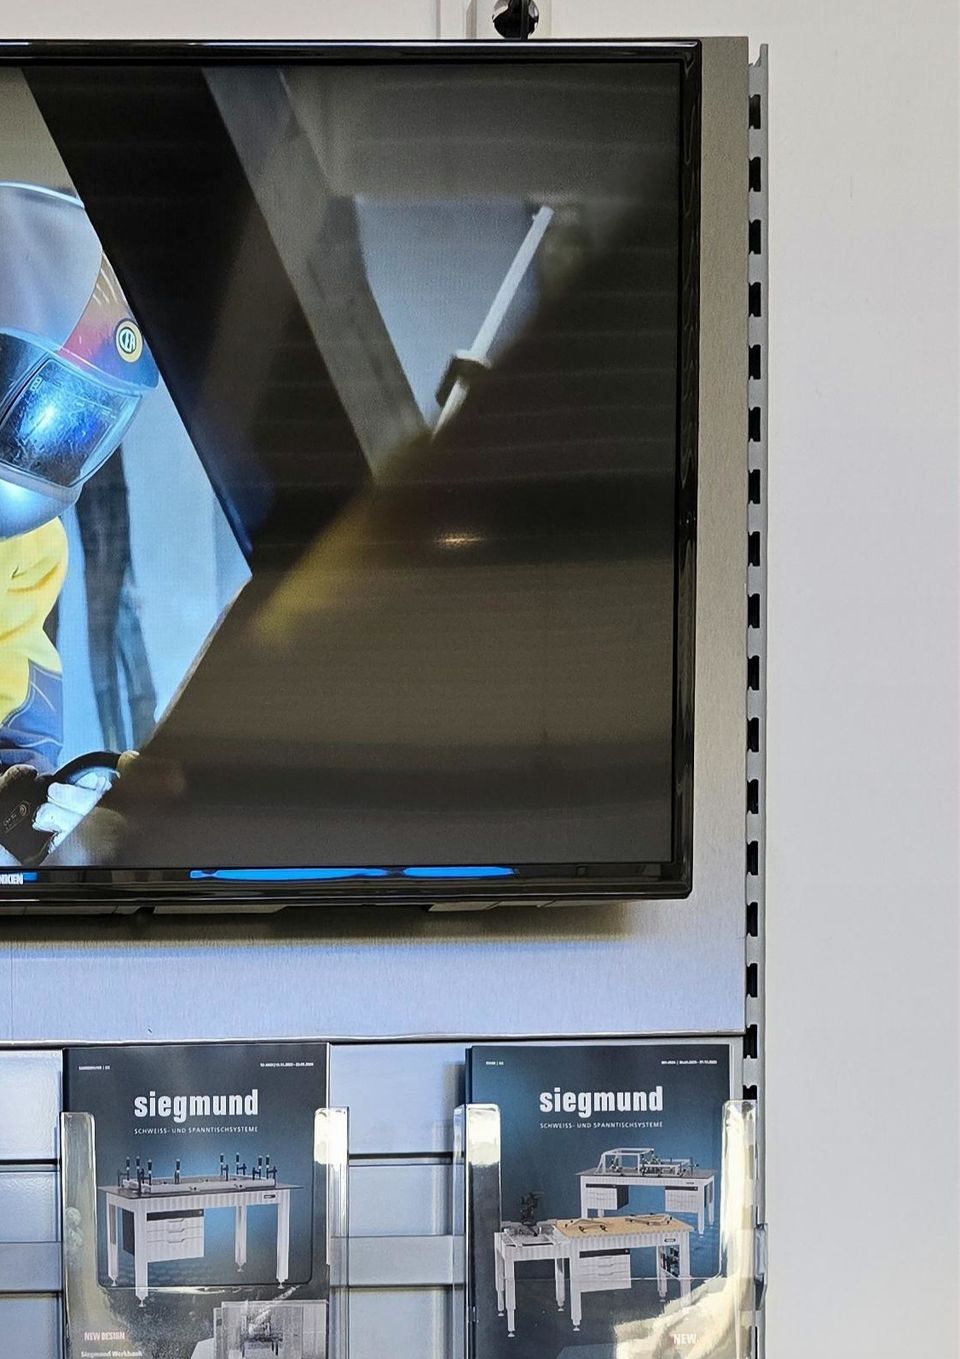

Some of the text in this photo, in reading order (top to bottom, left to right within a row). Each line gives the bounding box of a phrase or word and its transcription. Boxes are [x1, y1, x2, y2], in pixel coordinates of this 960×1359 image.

[134, 1089, 259, 1123] siegmund
[540, 1086, 663, 1118] siegmund
[188, 1126, 258, 1134] SPANNTISCHSYSTEME
[84, 1331, 125, 1341] NEW DESIGN
[673, 1334, 697, 1344] NEW
